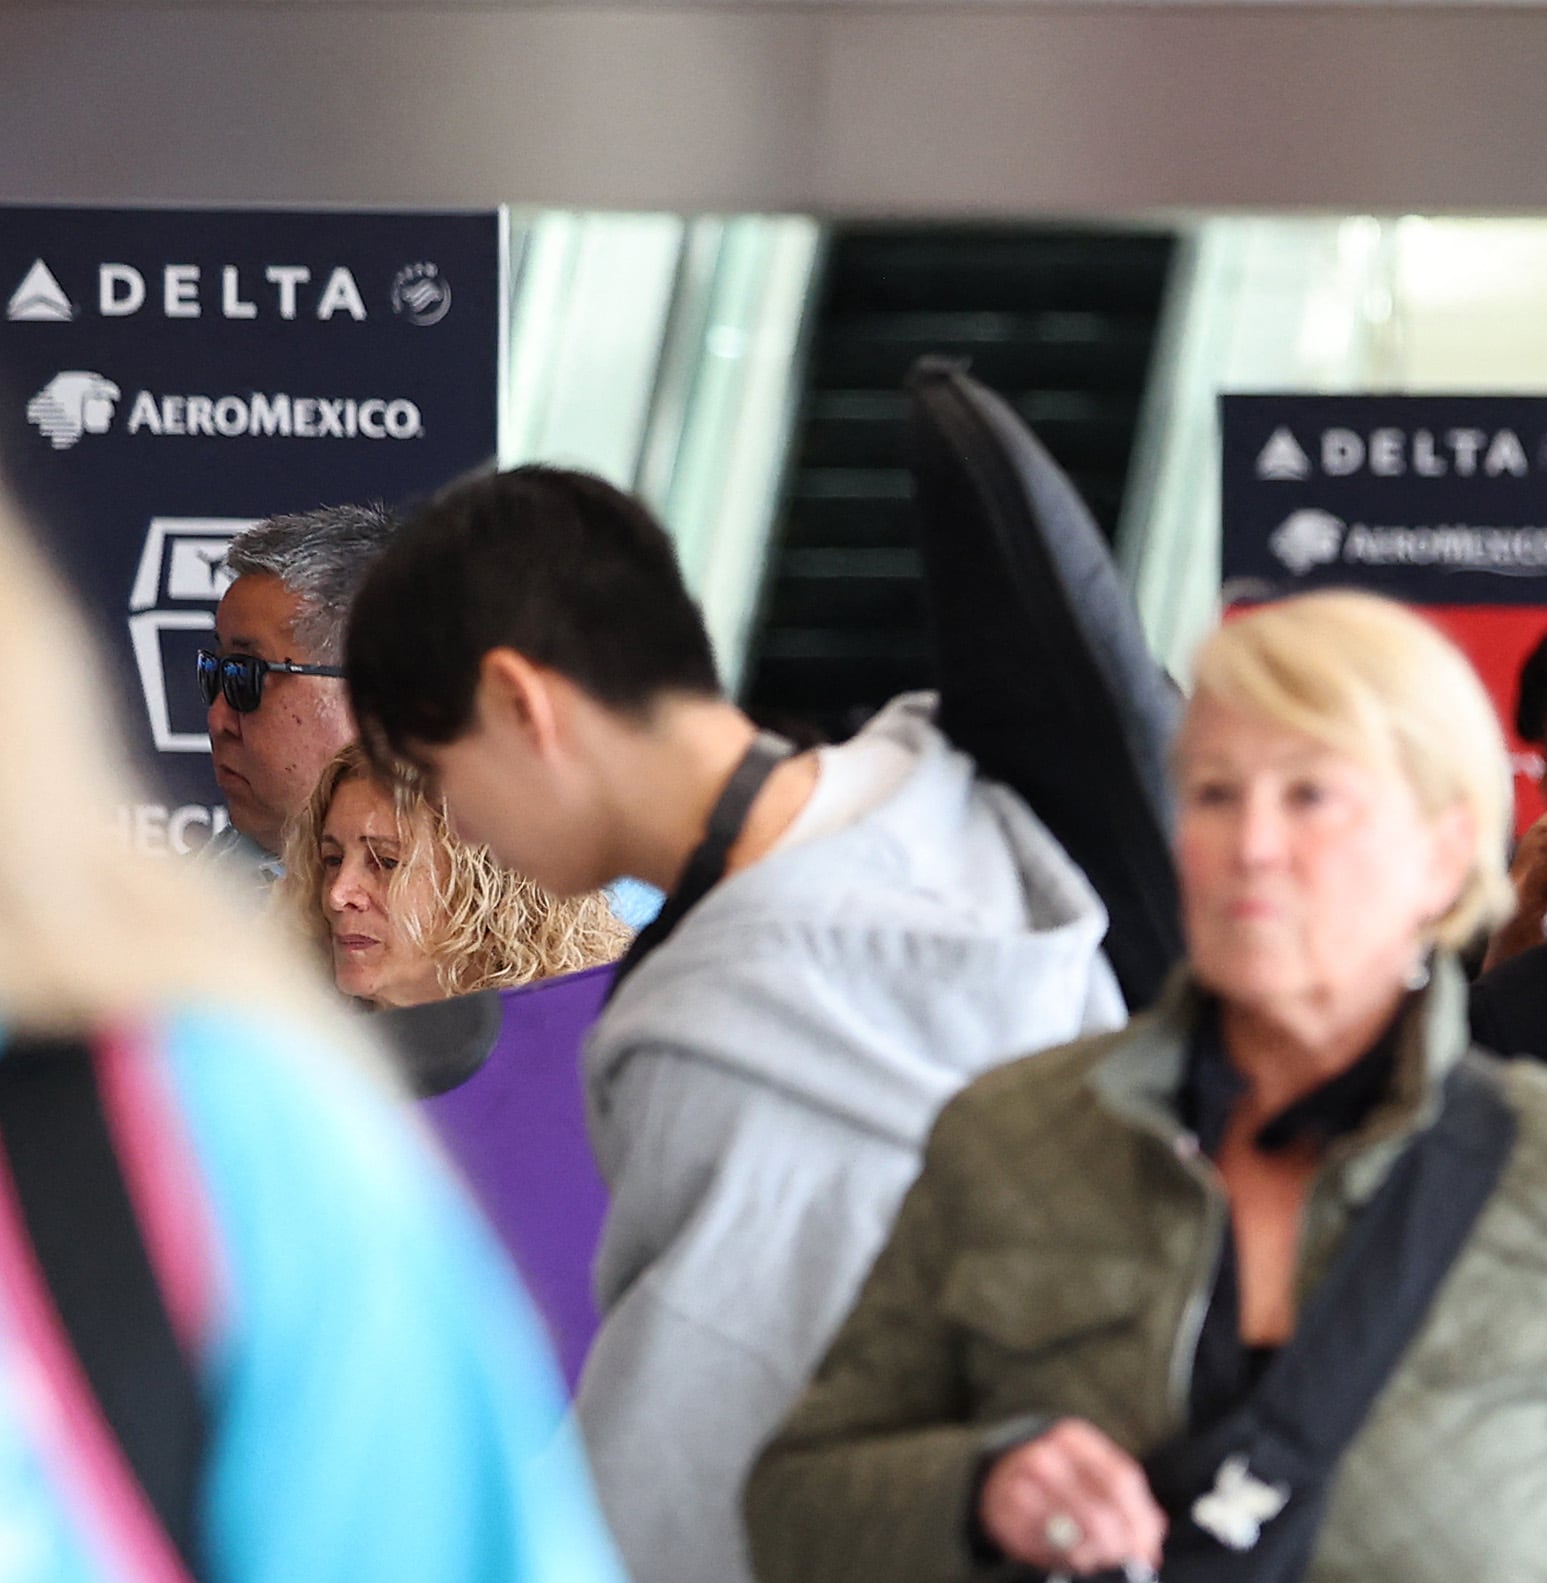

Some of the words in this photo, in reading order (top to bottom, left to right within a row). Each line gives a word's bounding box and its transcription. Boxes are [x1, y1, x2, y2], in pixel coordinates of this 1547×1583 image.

[100, 264, 367, 321] DELTA
[127, 390, 422, 440] AEROMEXICO
[1320, 427, 1529, 478] DELTA
